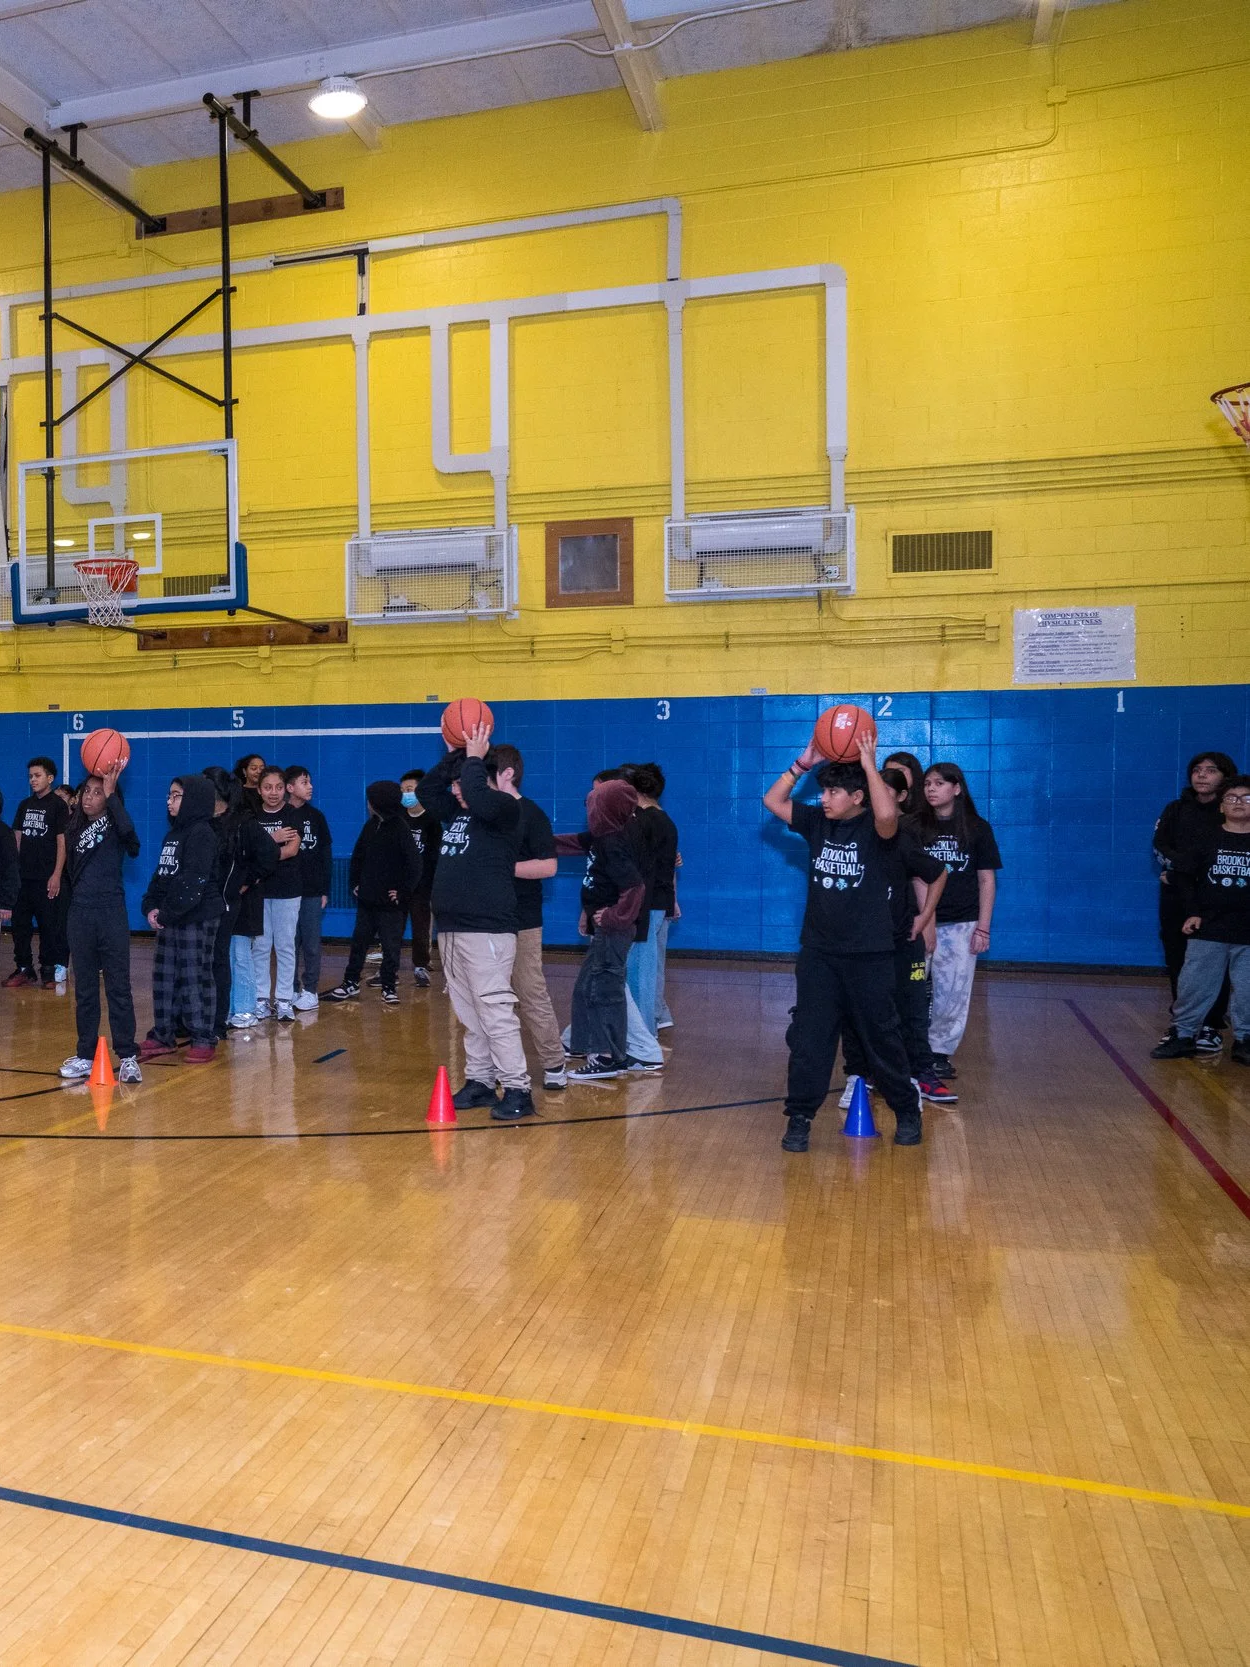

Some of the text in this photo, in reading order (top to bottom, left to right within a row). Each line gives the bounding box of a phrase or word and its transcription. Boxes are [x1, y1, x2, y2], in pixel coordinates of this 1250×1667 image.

[656, 700, 670, 720] 3
[877, 695, 893, 717] 2
[1116, 690, 1125, 713] 1
[73, 713, 84, 731] 6
[232, 709, 245, 729] 5
[929, 850, 965, 861] SKETBALL
[815, 857, 861, 876] BASETBALL
